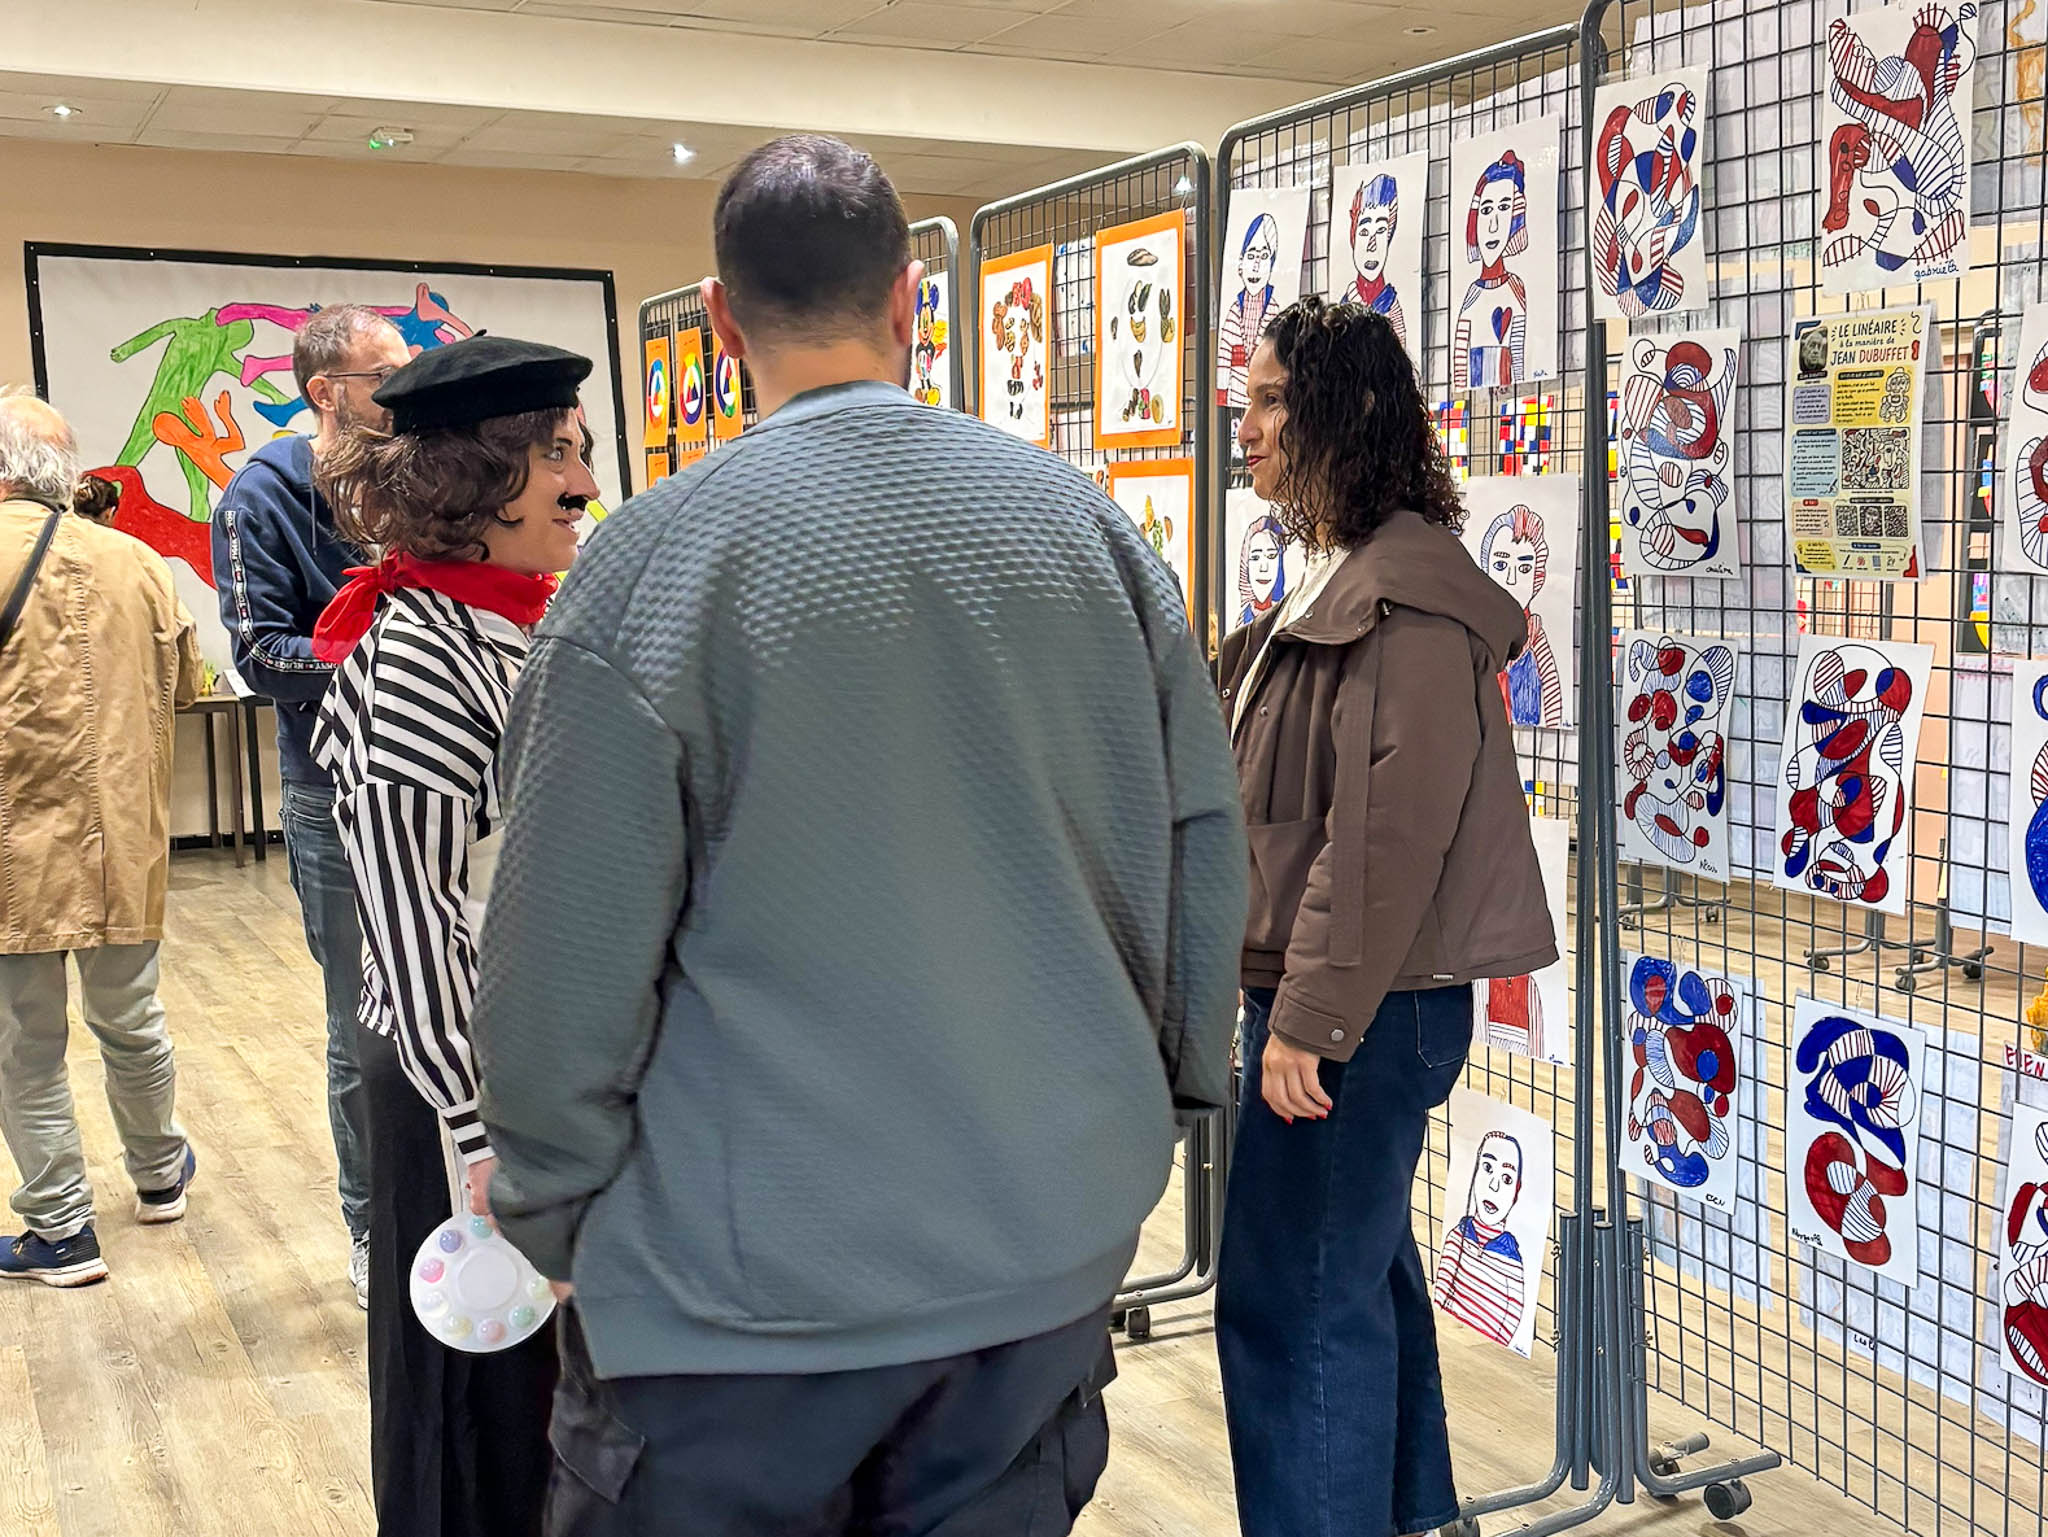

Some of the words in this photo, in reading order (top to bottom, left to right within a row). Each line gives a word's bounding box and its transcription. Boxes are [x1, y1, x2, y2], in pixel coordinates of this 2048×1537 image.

[1838, 323, 1850, 338] LE
[1852, 319, 1898, 337] LINÉAIRE
[1845, 339, 1853, 348] la
[1855, 337, 1884, 347] manière
[1886, 336, 1895, 345] de
[1830, 350, 1857, 366] JEAN
[1858, 345, 1910, 364] DUBUFFET
